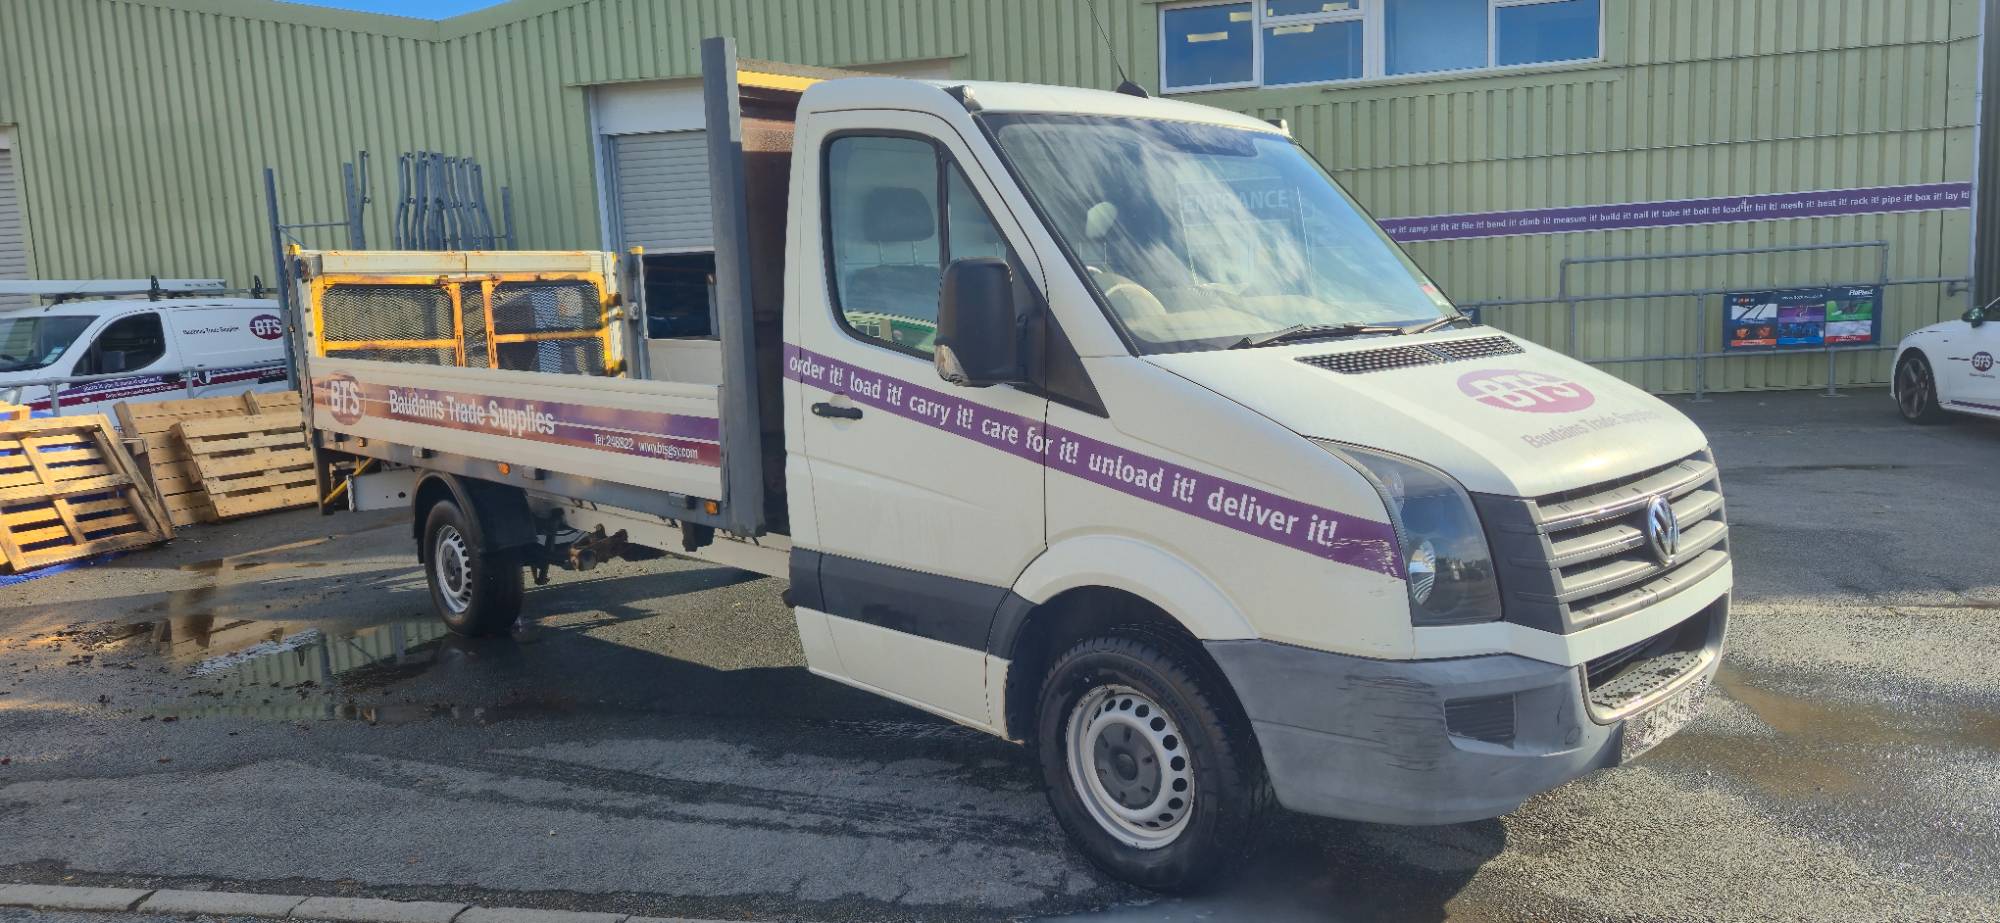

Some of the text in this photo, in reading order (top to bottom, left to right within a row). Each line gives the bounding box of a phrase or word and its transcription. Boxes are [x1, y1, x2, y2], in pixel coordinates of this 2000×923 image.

[1183, 189, 1288, 213] ENTRANCE
[1409, 225, 1429, 234] ramp
[1462, 221, 1474, 230] file
[1487, 219, 1506, 228] bend
[1519, 216, 1540, 226] climb
[1543, 216, 1551, 225] it!
[1553, 216, 1587, 225] measure
[1600, 212, 1621, 222] build
[1634, 210, 1649, 219] nail
[1652, 209, 1660, 218] it!
[1662, 209, 1680, 218] tube
[1683, 208, 1691, 217] it!
[1712, 205, 1720, 214] it!
[1723, 204, 1740, 214] load
[1780, 200, 1803, 210] mesh
[1850, 196, 1868, 206] rack
[1871, 195, 1879, 204] it!
[1882, 194, 1901, 206] pipe
[1904, 193, 1913, 203] it!
[1915, 193, 1931, 202] box
[1933, 192, 1942, 201] it!
[1945, 191, 1958, 201] lay
[255, 319, 282, 336] BTS
[330, 380, 360, 416] BTS
[388, 389, 555, 437] Baudains Trade Supplies
[594, 433, 606, 447] Tel:
[1520, 423, 1589, 448] Baudains
[790, 355, 1338, 548] order it! load it! carry it! care for it! unload it! deliver it!
